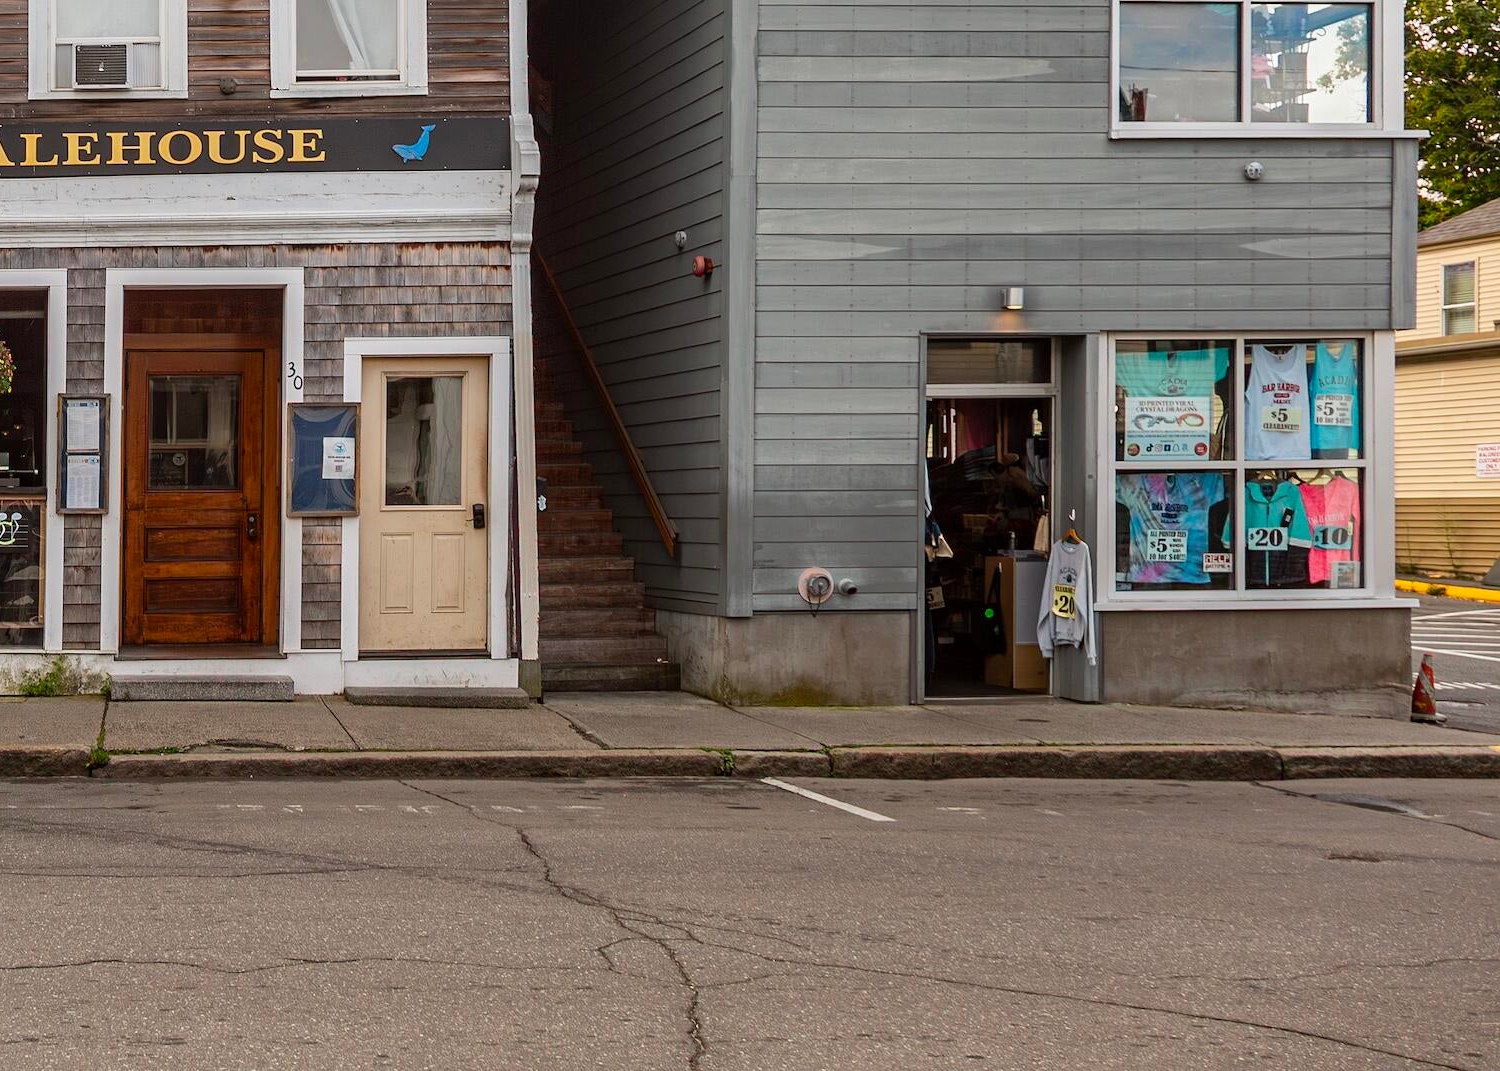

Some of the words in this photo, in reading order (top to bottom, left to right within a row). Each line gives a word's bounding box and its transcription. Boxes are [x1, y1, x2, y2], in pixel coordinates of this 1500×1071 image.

[1271, 408, 1288, 422] $5
[1316, 402, 1334, 416] $5
[1250, 528, 1283, 546] $20
[1314, 527, 1349, 545] $10
[1150, 538, 1168, 553] $5
[1054, 595, 1075, 615] $20
